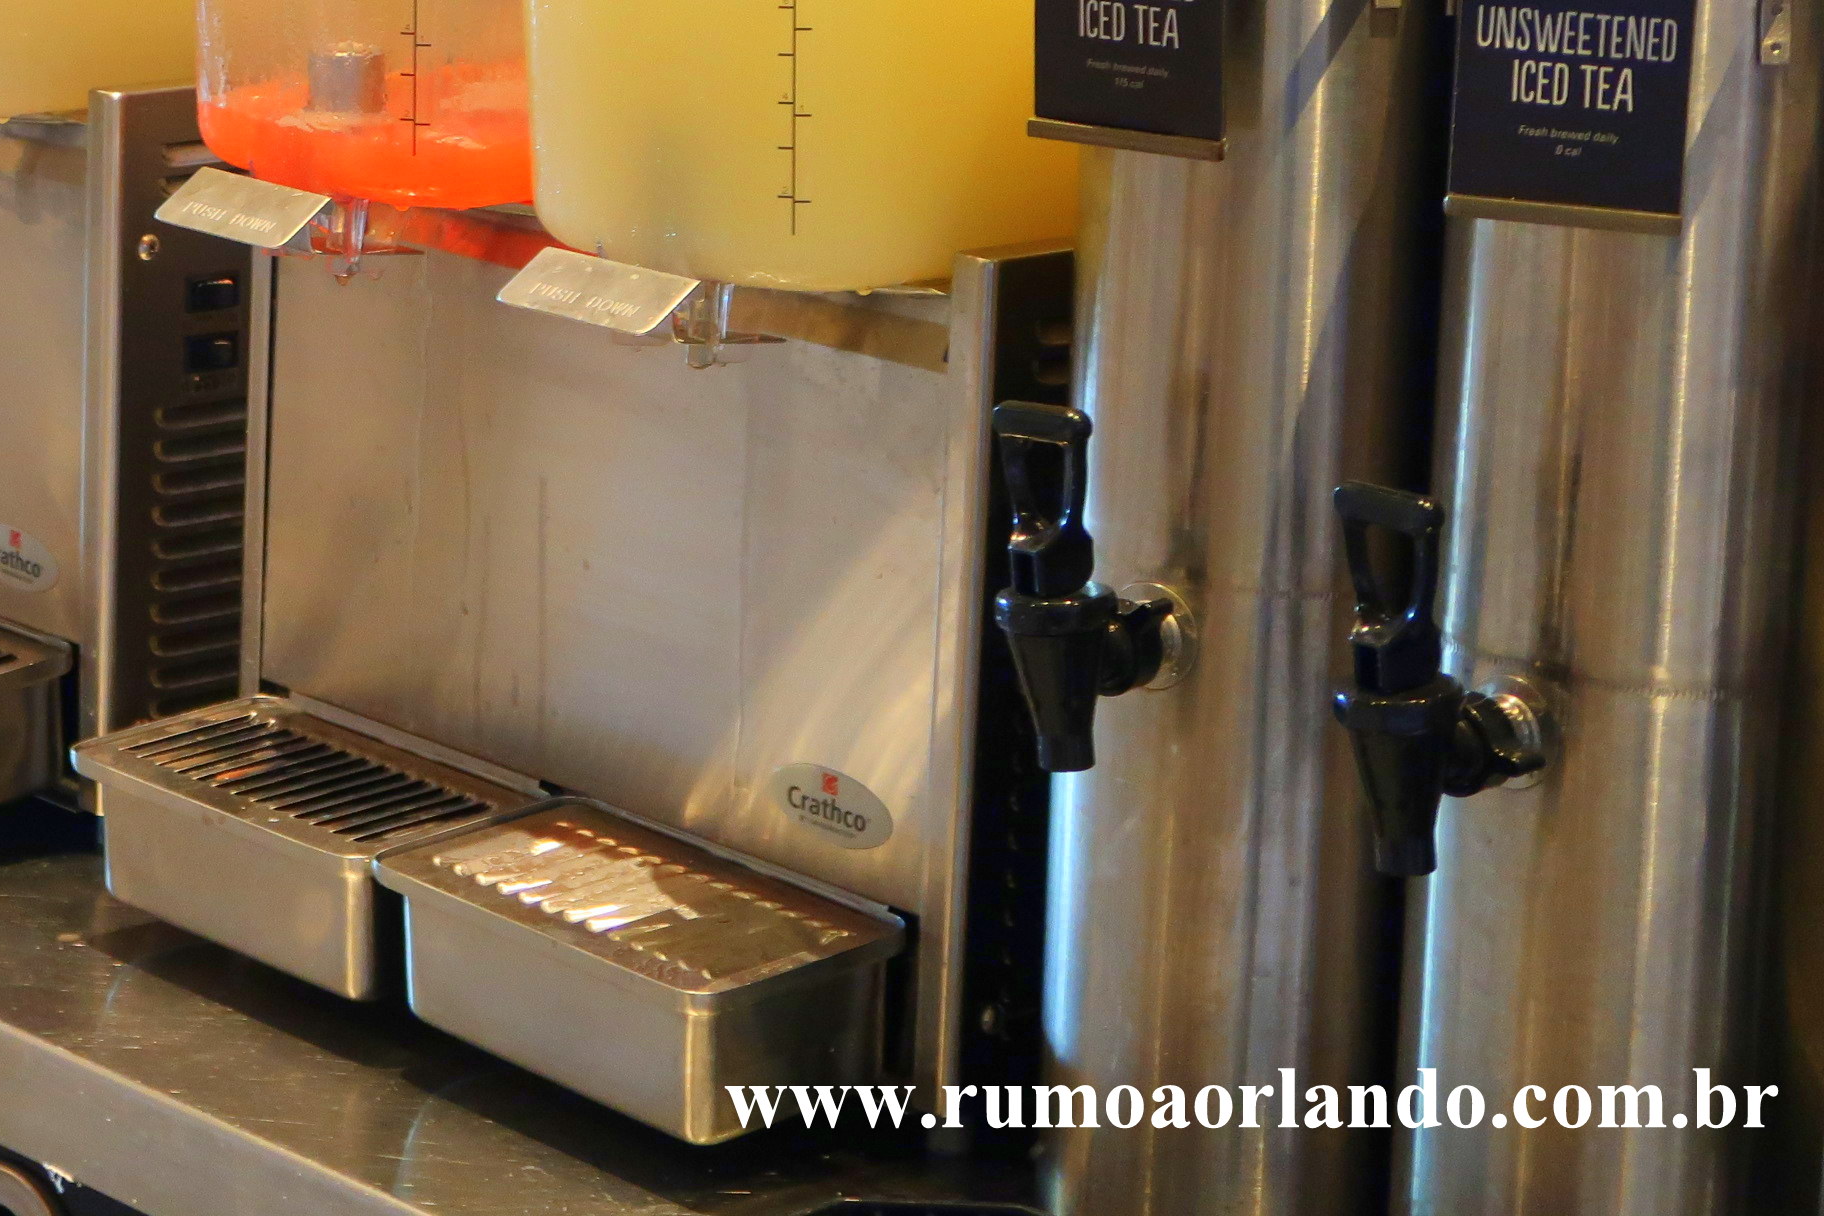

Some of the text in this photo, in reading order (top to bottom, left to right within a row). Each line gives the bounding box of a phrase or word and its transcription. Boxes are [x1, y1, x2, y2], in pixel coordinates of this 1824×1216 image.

[1134, 3, 1180, 50] TEA
[1477, 4, 1678, 64] UNSWEETENED
[1511, 59, 1634, 114] ICED TEA
[1518, 124, 1549, 138] Fresh
[181, 200, 277, 234] PUSH DOWN
[529, 281, 642, 318] PUSH DOWN
[787, 784, 867, 833] Crathco
